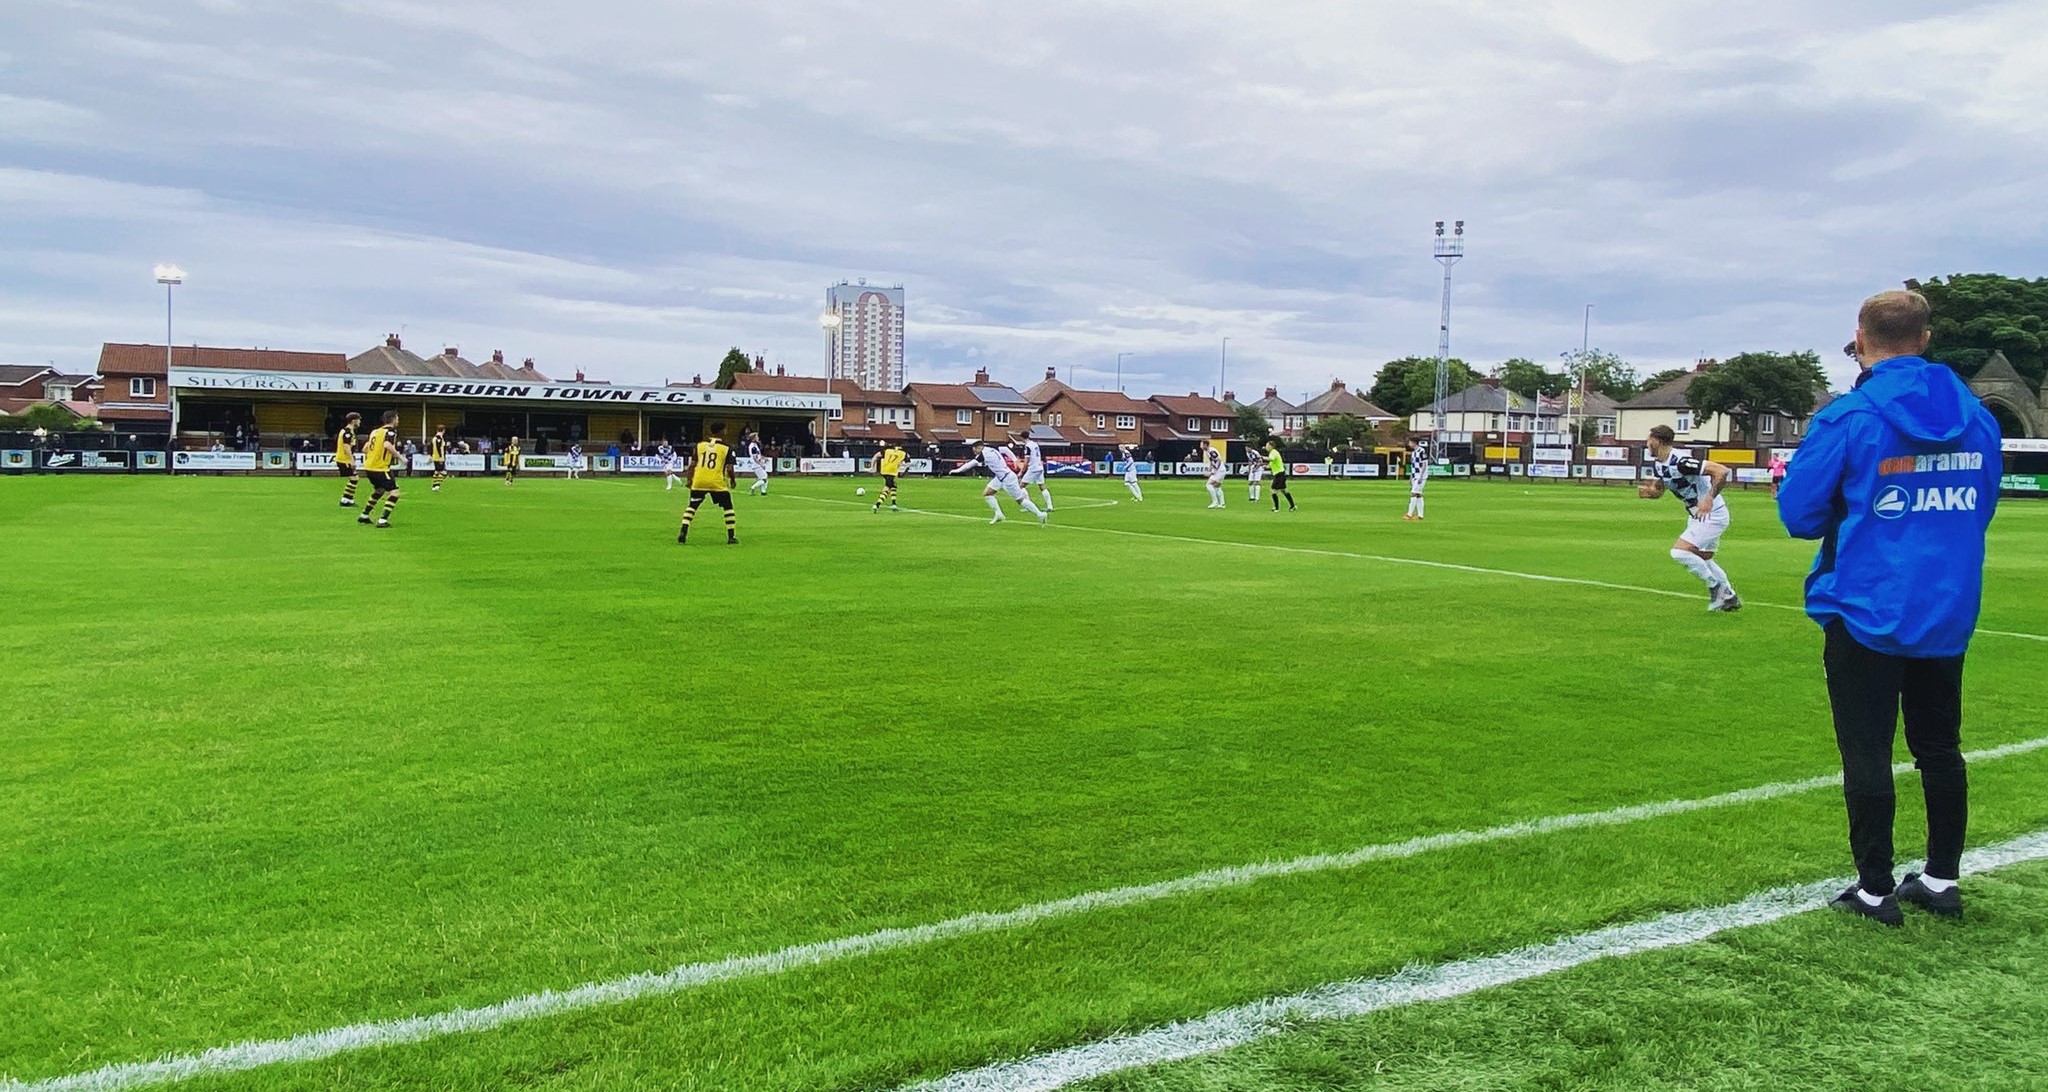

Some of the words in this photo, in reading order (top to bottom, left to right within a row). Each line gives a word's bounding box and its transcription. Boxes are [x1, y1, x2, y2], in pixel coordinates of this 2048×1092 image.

[188, 376, 330, 391] SILVERGATE
[368, 380, 531, 397] HEBBURN
[543, 387, 632, 401] TOWN
[639, 391, 694, 403] F.C.
[370, 436, 376, 451] 8
[701, 451, 717, 470] 18
[1911, 486, 1978, 512] JAKO
